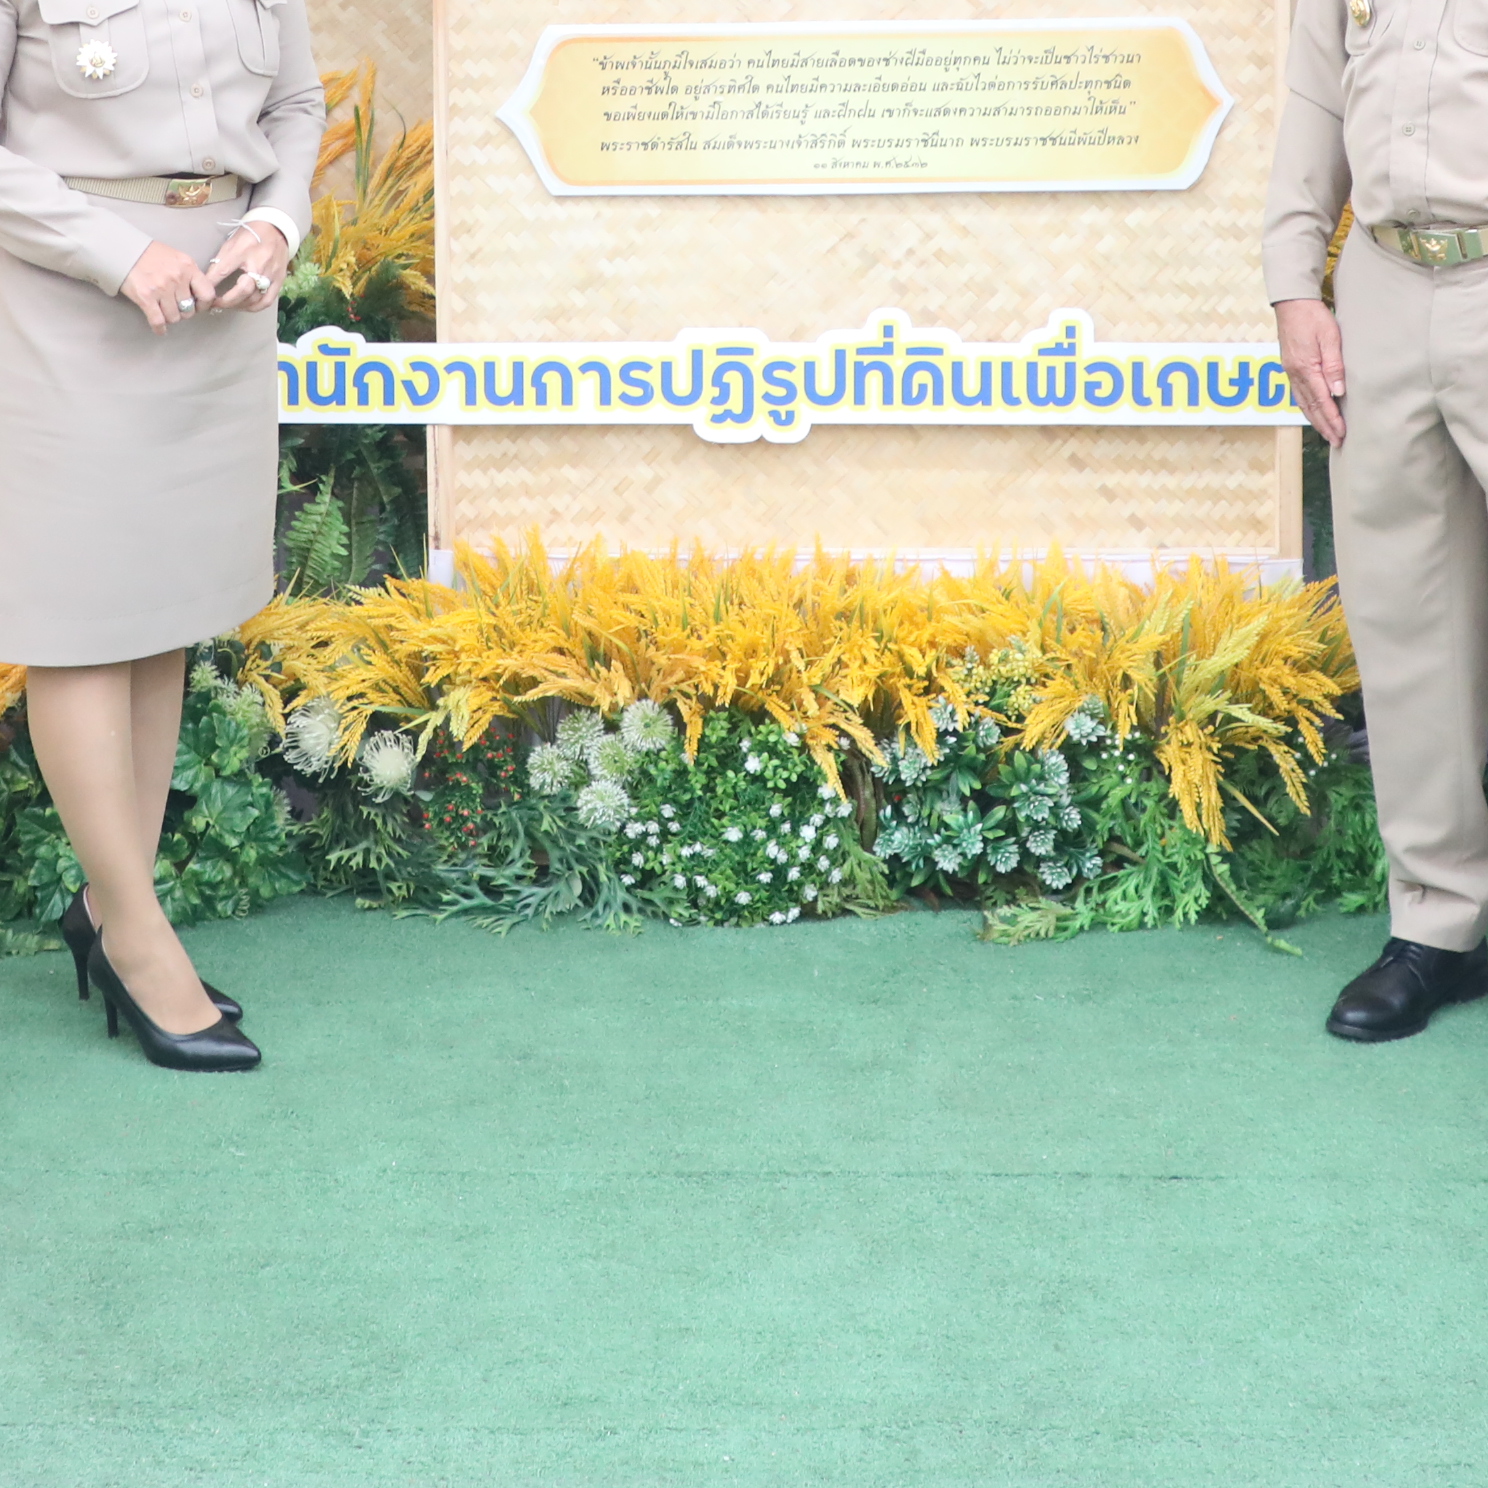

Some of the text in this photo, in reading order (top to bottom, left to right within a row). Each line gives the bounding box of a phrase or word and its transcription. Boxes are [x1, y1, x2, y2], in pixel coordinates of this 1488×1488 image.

[747, 48, 990, 73] คนไทยมีสายเลือดของช่างฝีมืออยู่ทุกคน
[995, 45, 1142, 66] ไม่ว่าจะเป็นชาวไร่ชาวนา
[601, 71, 1132, 101] หรืออาชีพใด อยู่สารทิศใด คนไทยมีความละเอียดอ่อน และฉับไวต่อการรับศิลปะทุกชนิด
[603, 101, 811, 125] ขอเพียงแต่ให้เขามีโอกาสได้เรียนรู้
[814, 99, 877, 120] และฝึกฝน
[600, 125, 1140, 152] พระราชดำรัสใน สมเด็จพระนางเจ้าสิริกิติ์ พระบรมราชินีนาถ พระบรมราชชนนีพันปีหลวง
[830, 156, 870, 170] สิงหาคม
[277, 324, 1300, 426] านักงานการปฏิรูปที่ดินเพื่อเกษต
